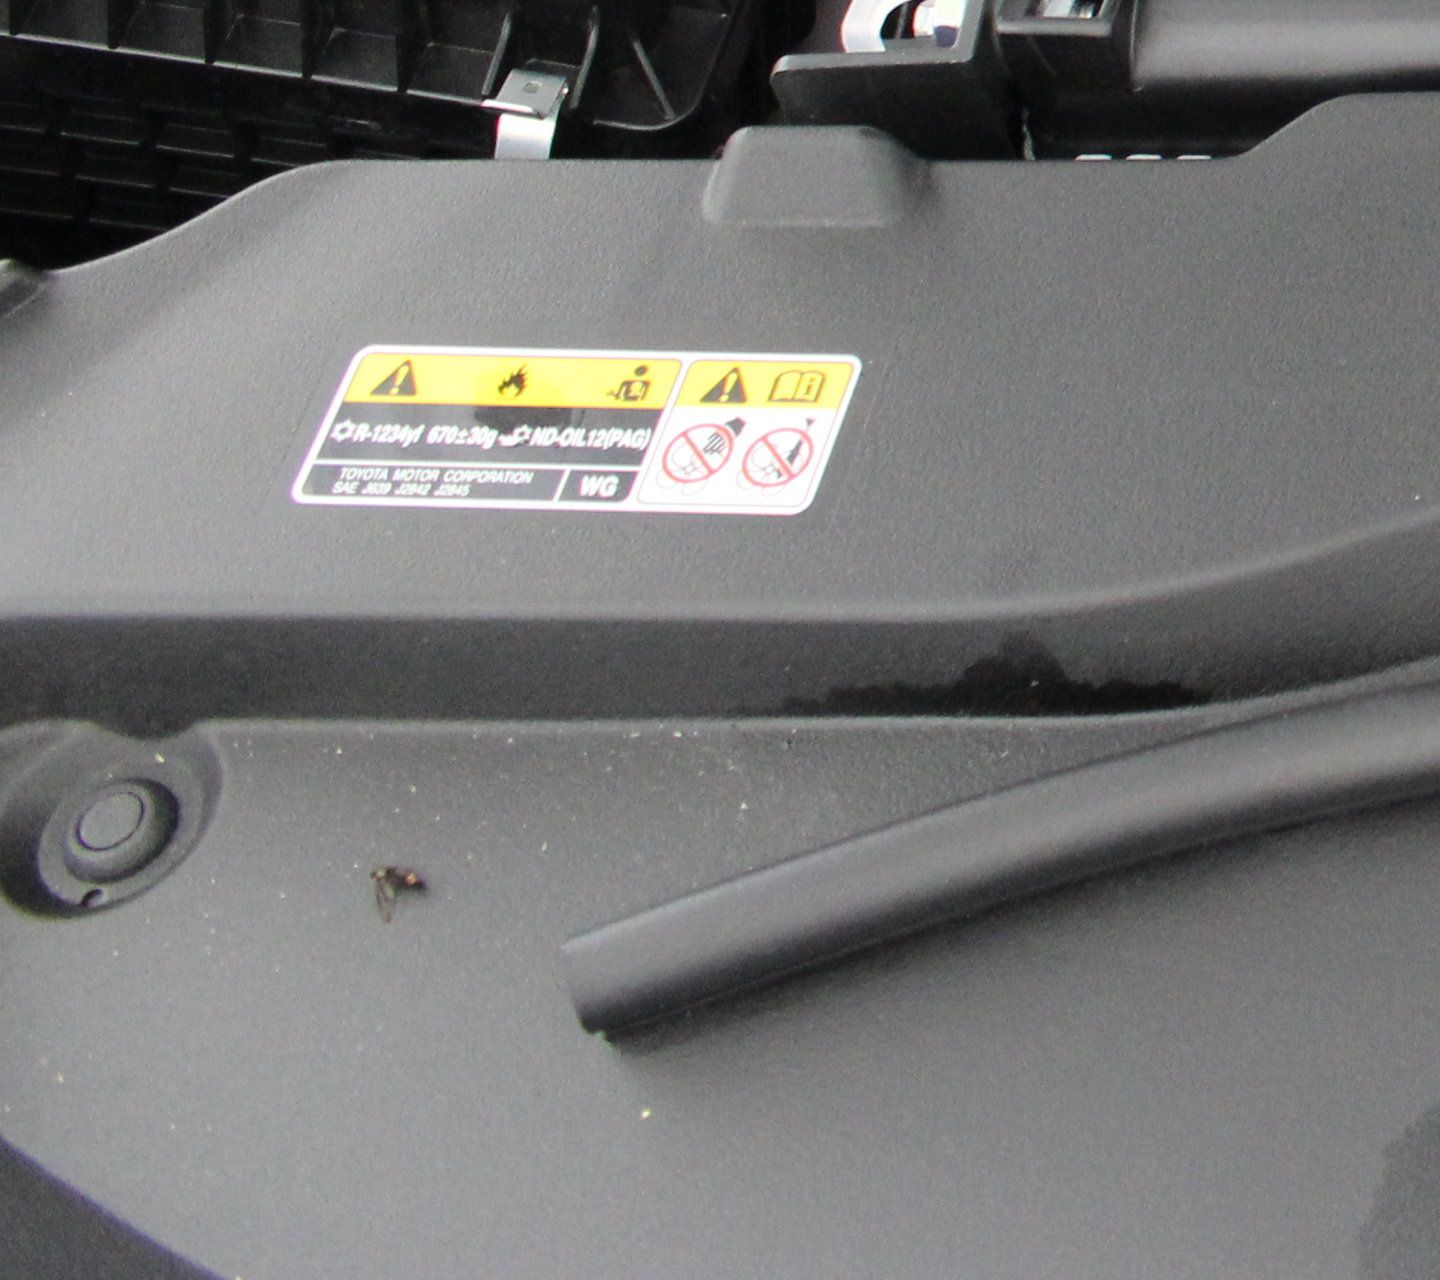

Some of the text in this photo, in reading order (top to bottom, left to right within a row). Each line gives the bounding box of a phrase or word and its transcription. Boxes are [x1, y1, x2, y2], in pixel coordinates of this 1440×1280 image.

[339, 466, 534, 485] TOYOTA MOTOR CORPORATION
[331, 480, 357, 495] SAE
[578, 475, 620, 498] WG
